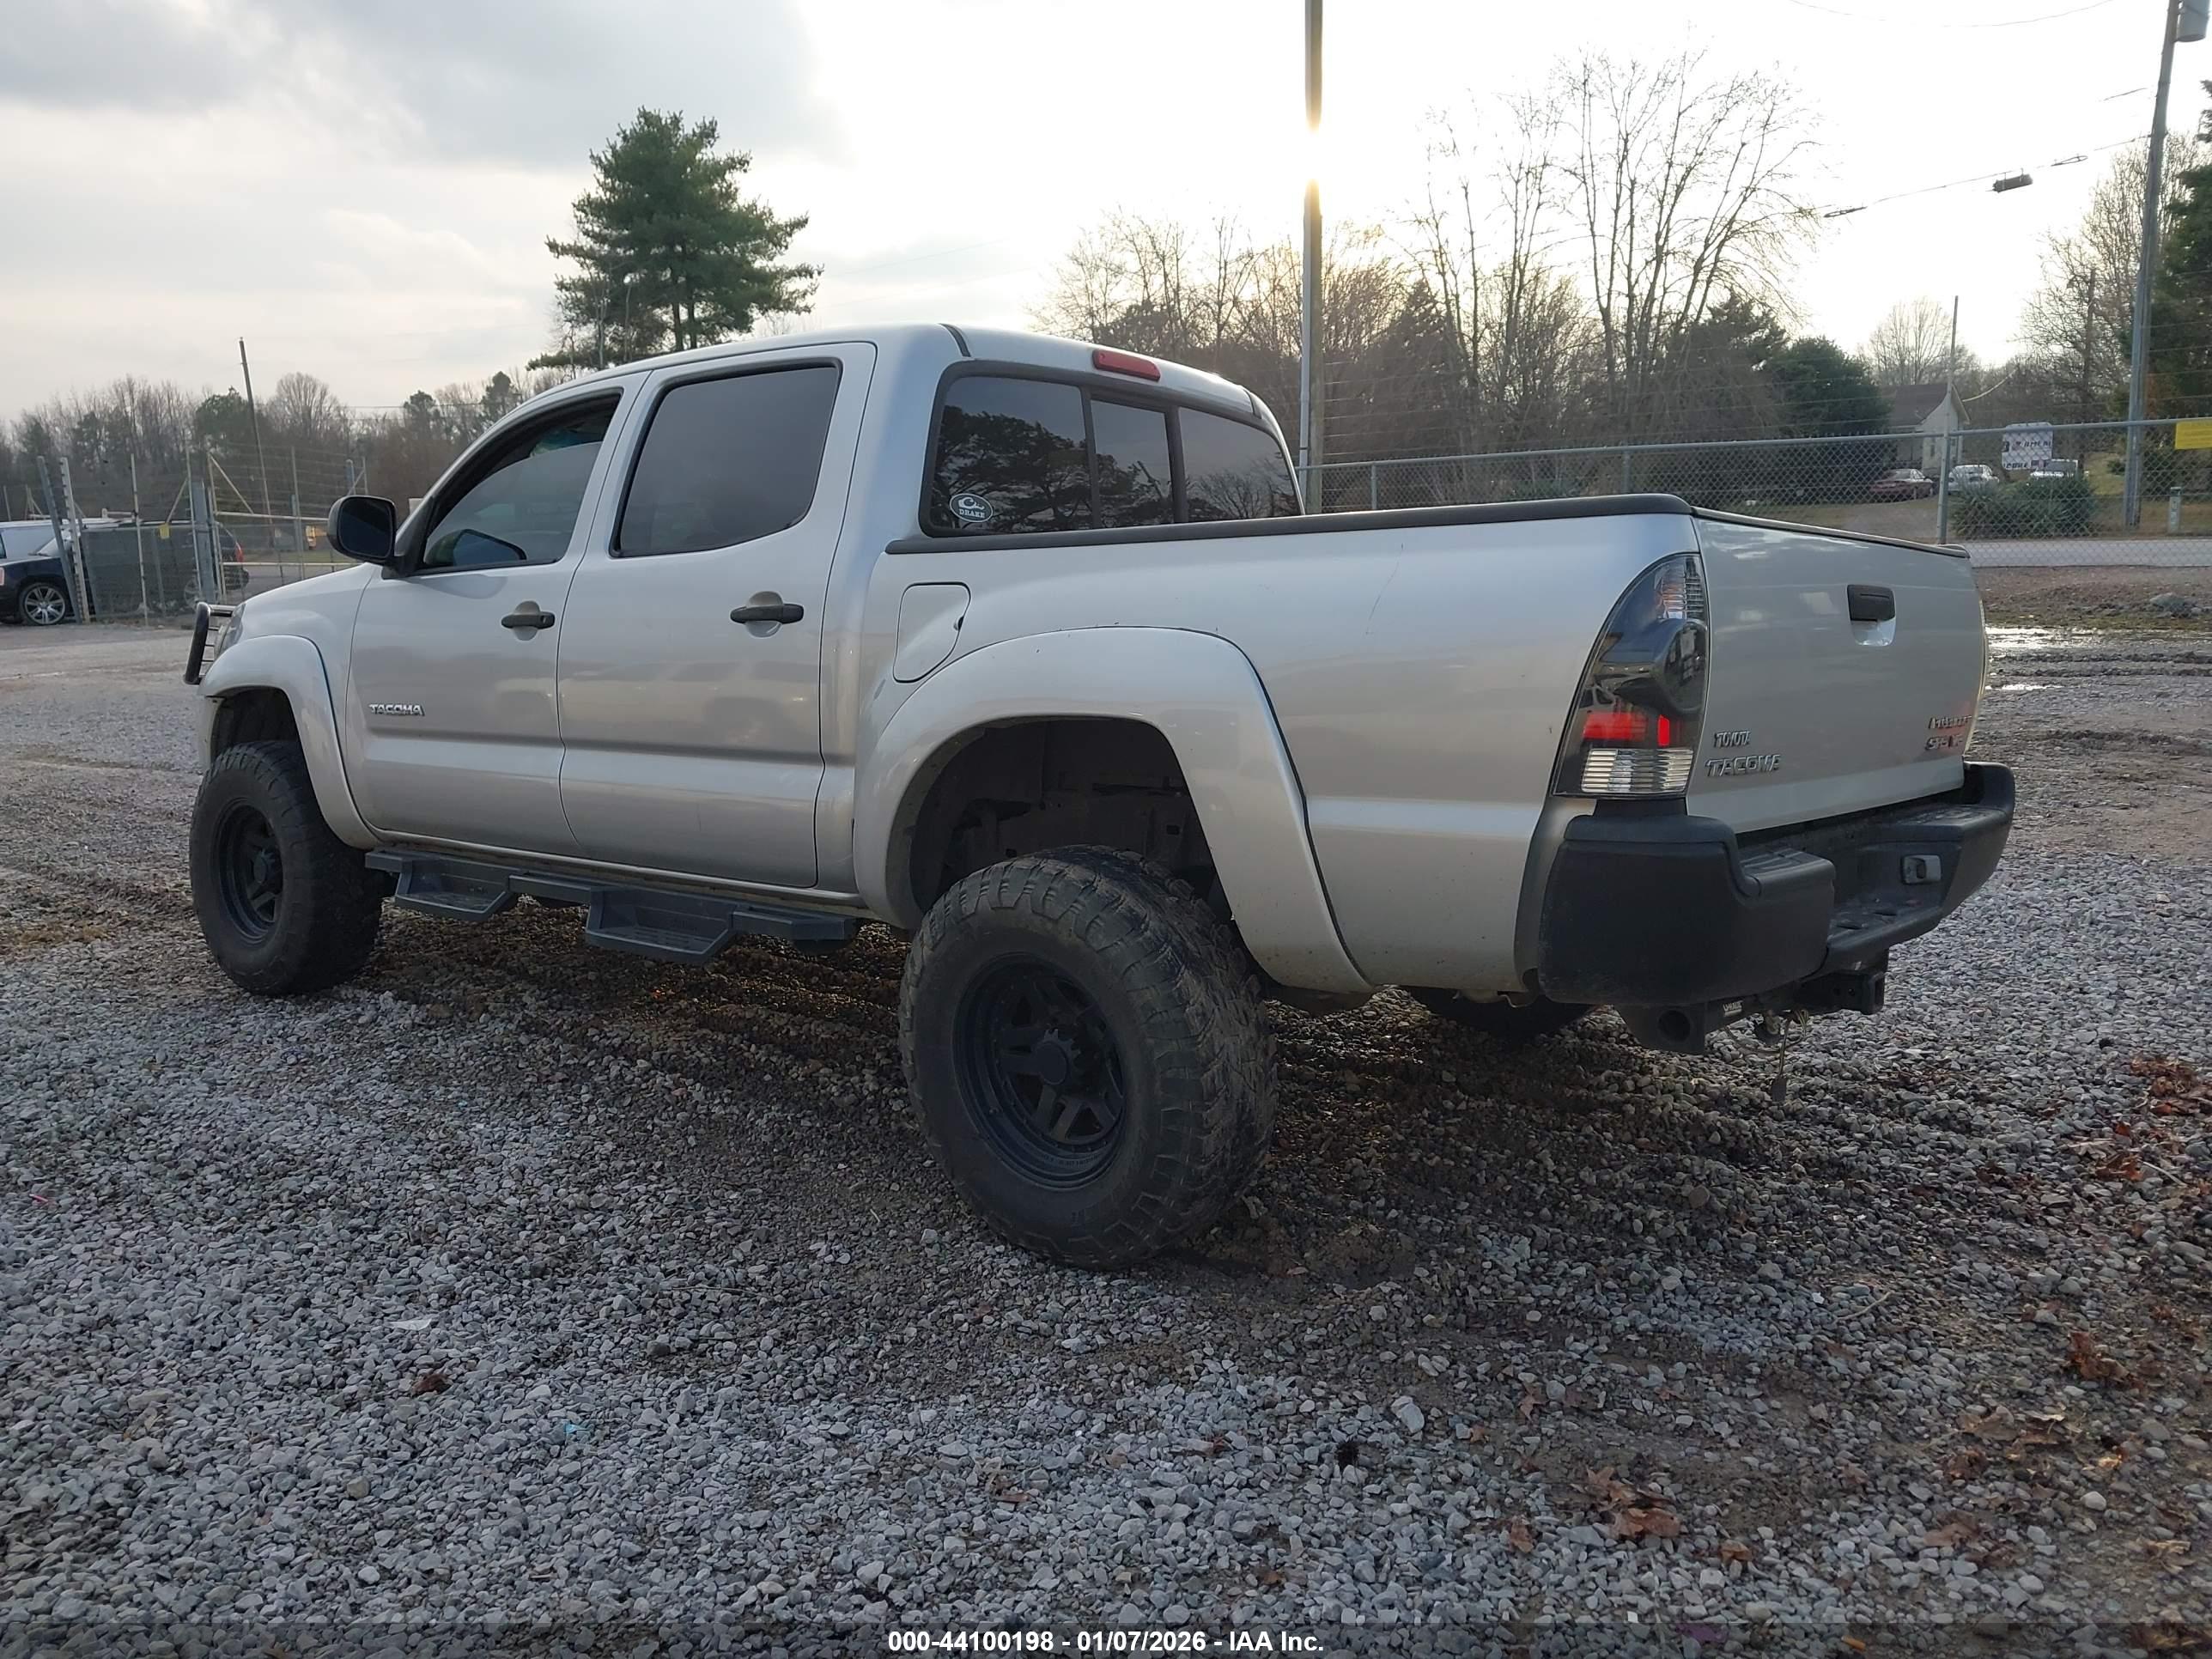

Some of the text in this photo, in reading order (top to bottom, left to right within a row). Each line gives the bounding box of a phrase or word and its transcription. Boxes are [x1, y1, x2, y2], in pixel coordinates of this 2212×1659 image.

[959, 509, 985, 518] DRAKE
[368, 703, 425, 716] TACOMA
[1714, 730, 1751, 748] TOYOTA
[1705, 754, 1781, 776] TACOMA
